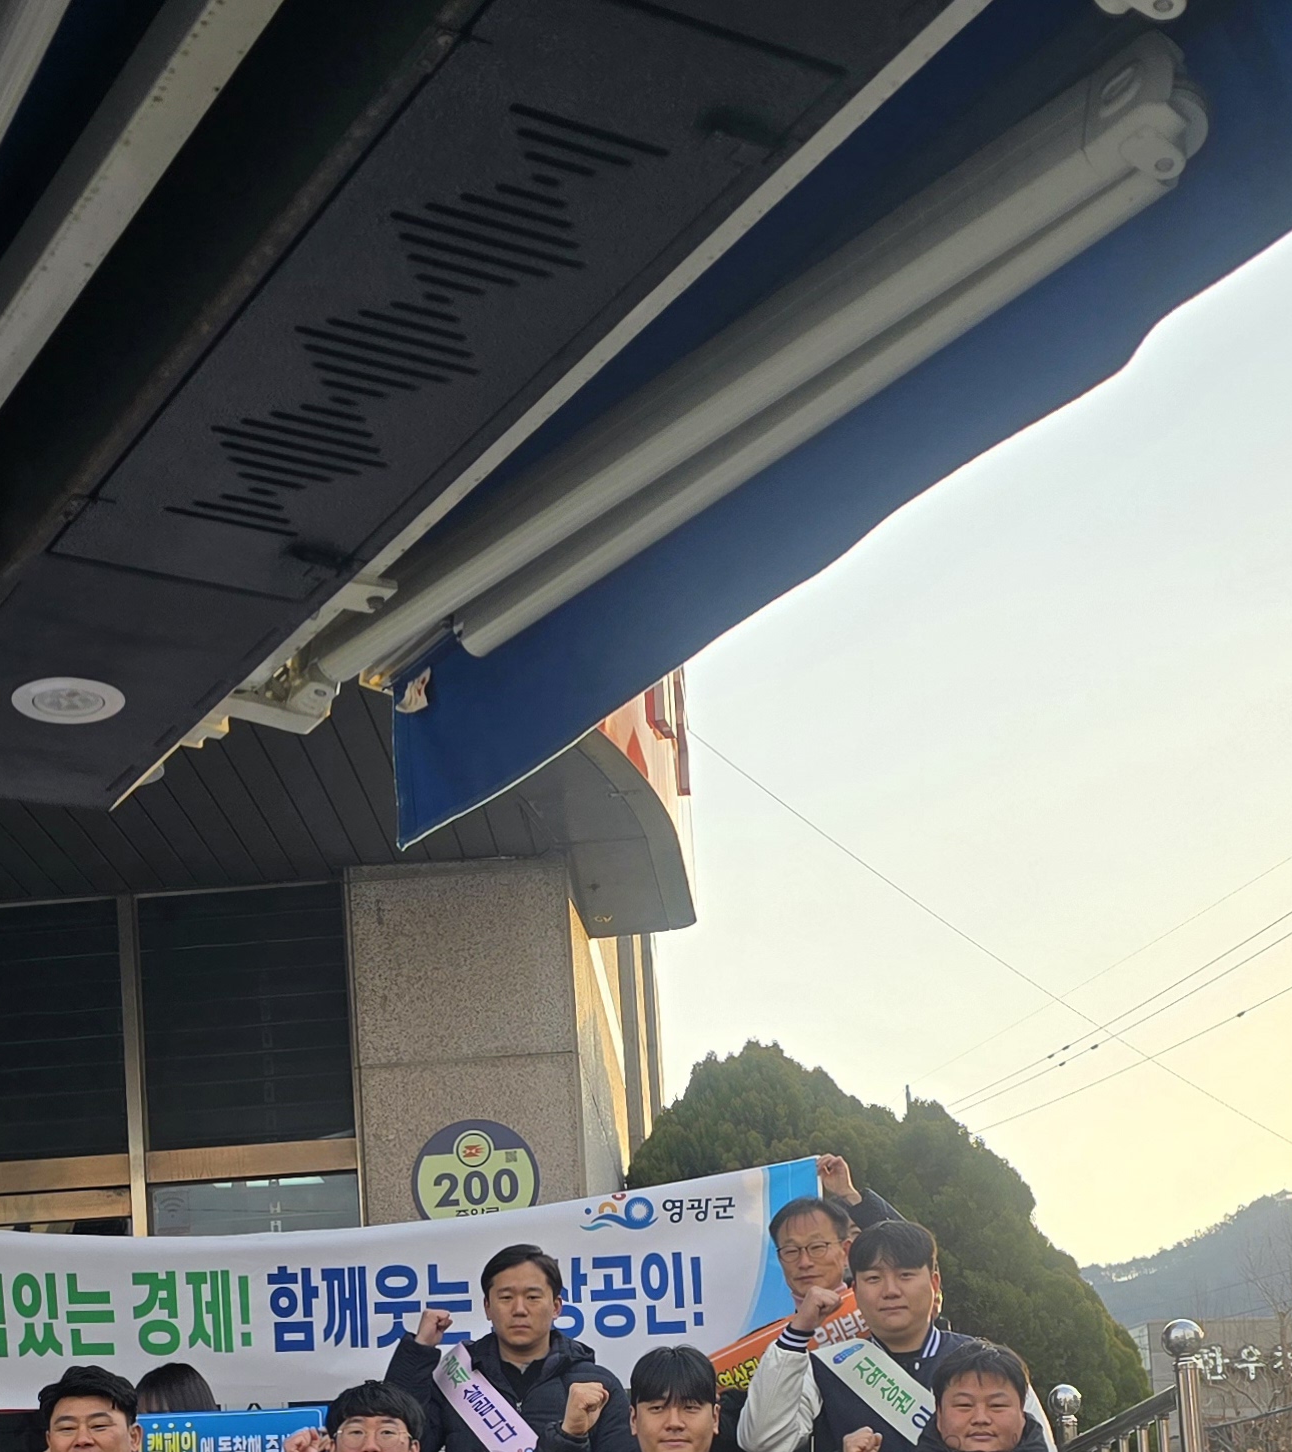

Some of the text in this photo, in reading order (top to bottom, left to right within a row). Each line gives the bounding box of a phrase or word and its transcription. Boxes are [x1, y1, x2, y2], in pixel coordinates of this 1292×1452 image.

[433, 1168, 519, 1209] 200
[662, 1196, 736, 1223] 영광군
[131, 1270, 252, 1356] 경제!
[267, 1264, 473, 1352] 함께웃는
[462, 1383, 518, 1444] 살립니다
[852, 1356, 917, 1416] 지역상권
